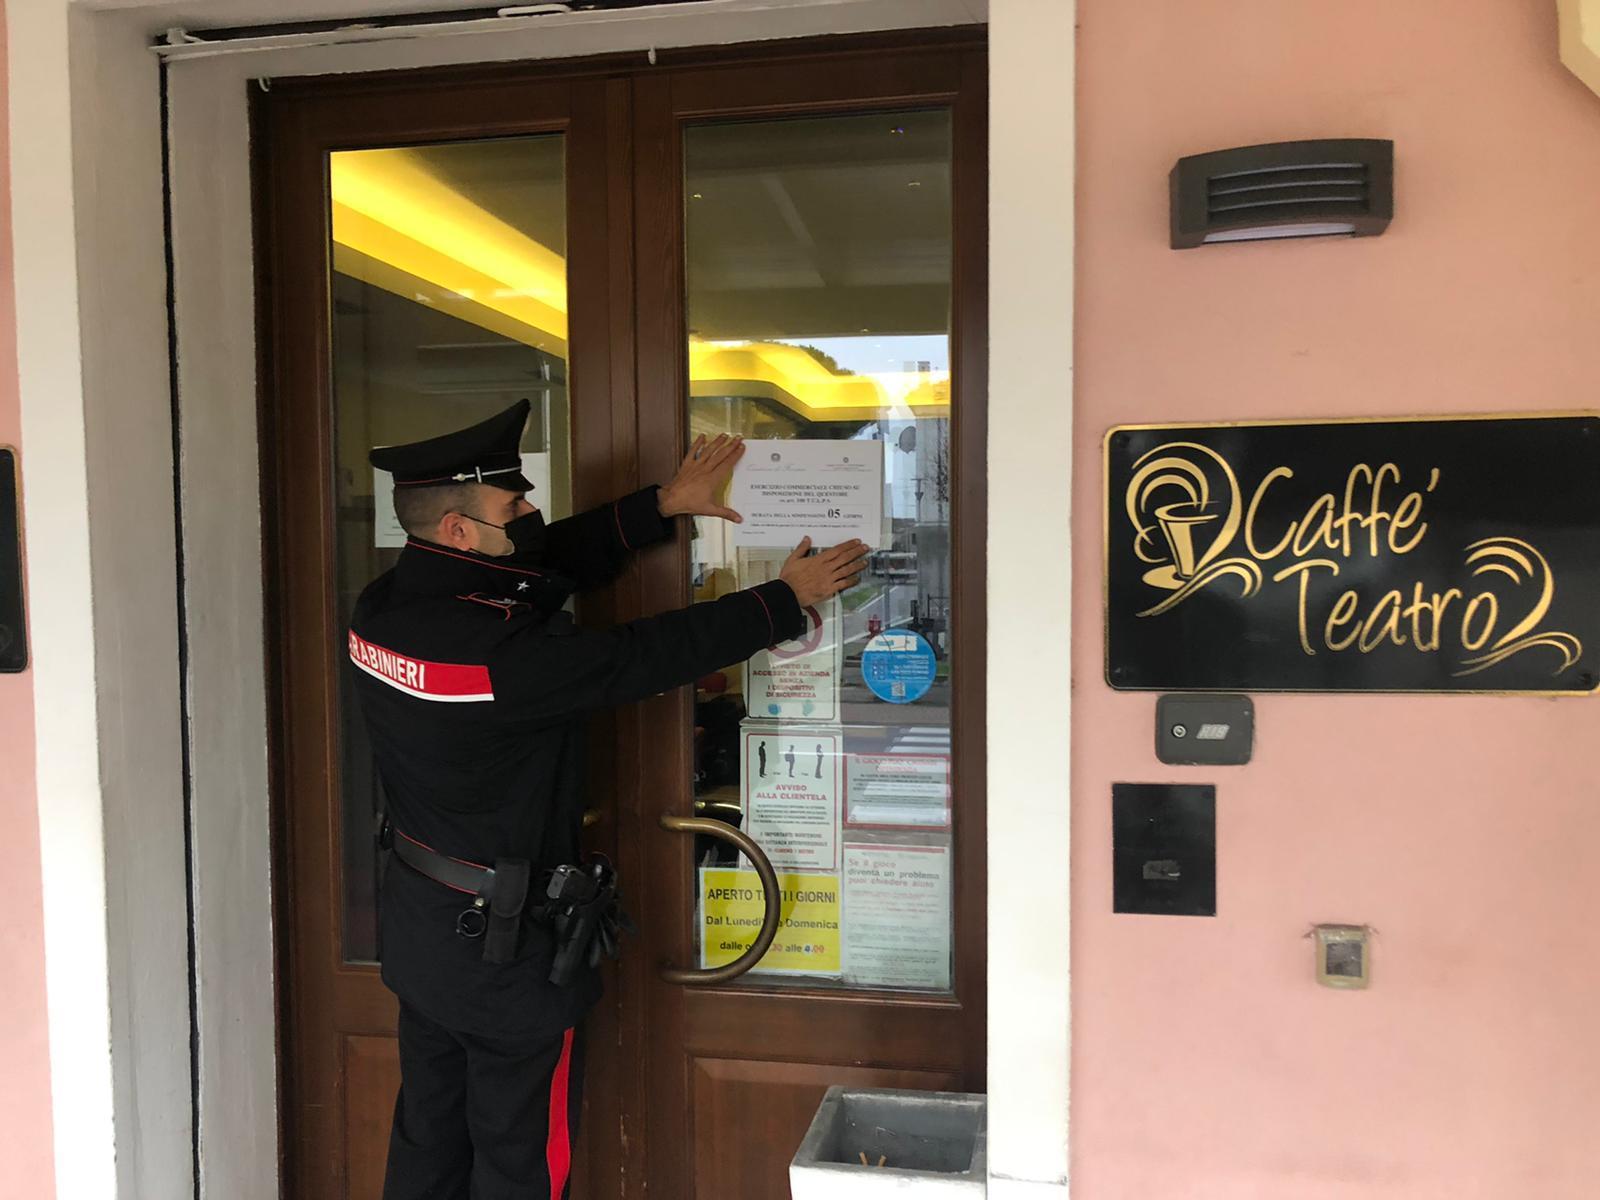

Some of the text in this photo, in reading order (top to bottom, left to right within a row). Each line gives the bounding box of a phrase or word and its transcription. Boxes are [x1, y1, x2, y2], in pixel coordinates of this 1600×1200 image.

[827, 508, 841, 519] 05
[1273, 559, 1498, 655] Teatro
[349, 634, 425, 690] RABINIERI
[780, 793, 827, 801] CLIENTELA
[848, 857, 859, 866] Se
[873, 861, 897, 869] gioco
[848, 868, 880, 876] diventa
[899, 871, 940, 880] problema
[871, 877, 908, 887] chiedere
[707, 889, 753, 901] APERTO
[796, 891, 836, 903] GIORNI
[706, 915, 723, 925] Dal
[785, 918, 839, 930] Domenica
[720, 941, 743, 951] dalle
[785, 944, 802, 953] alle
